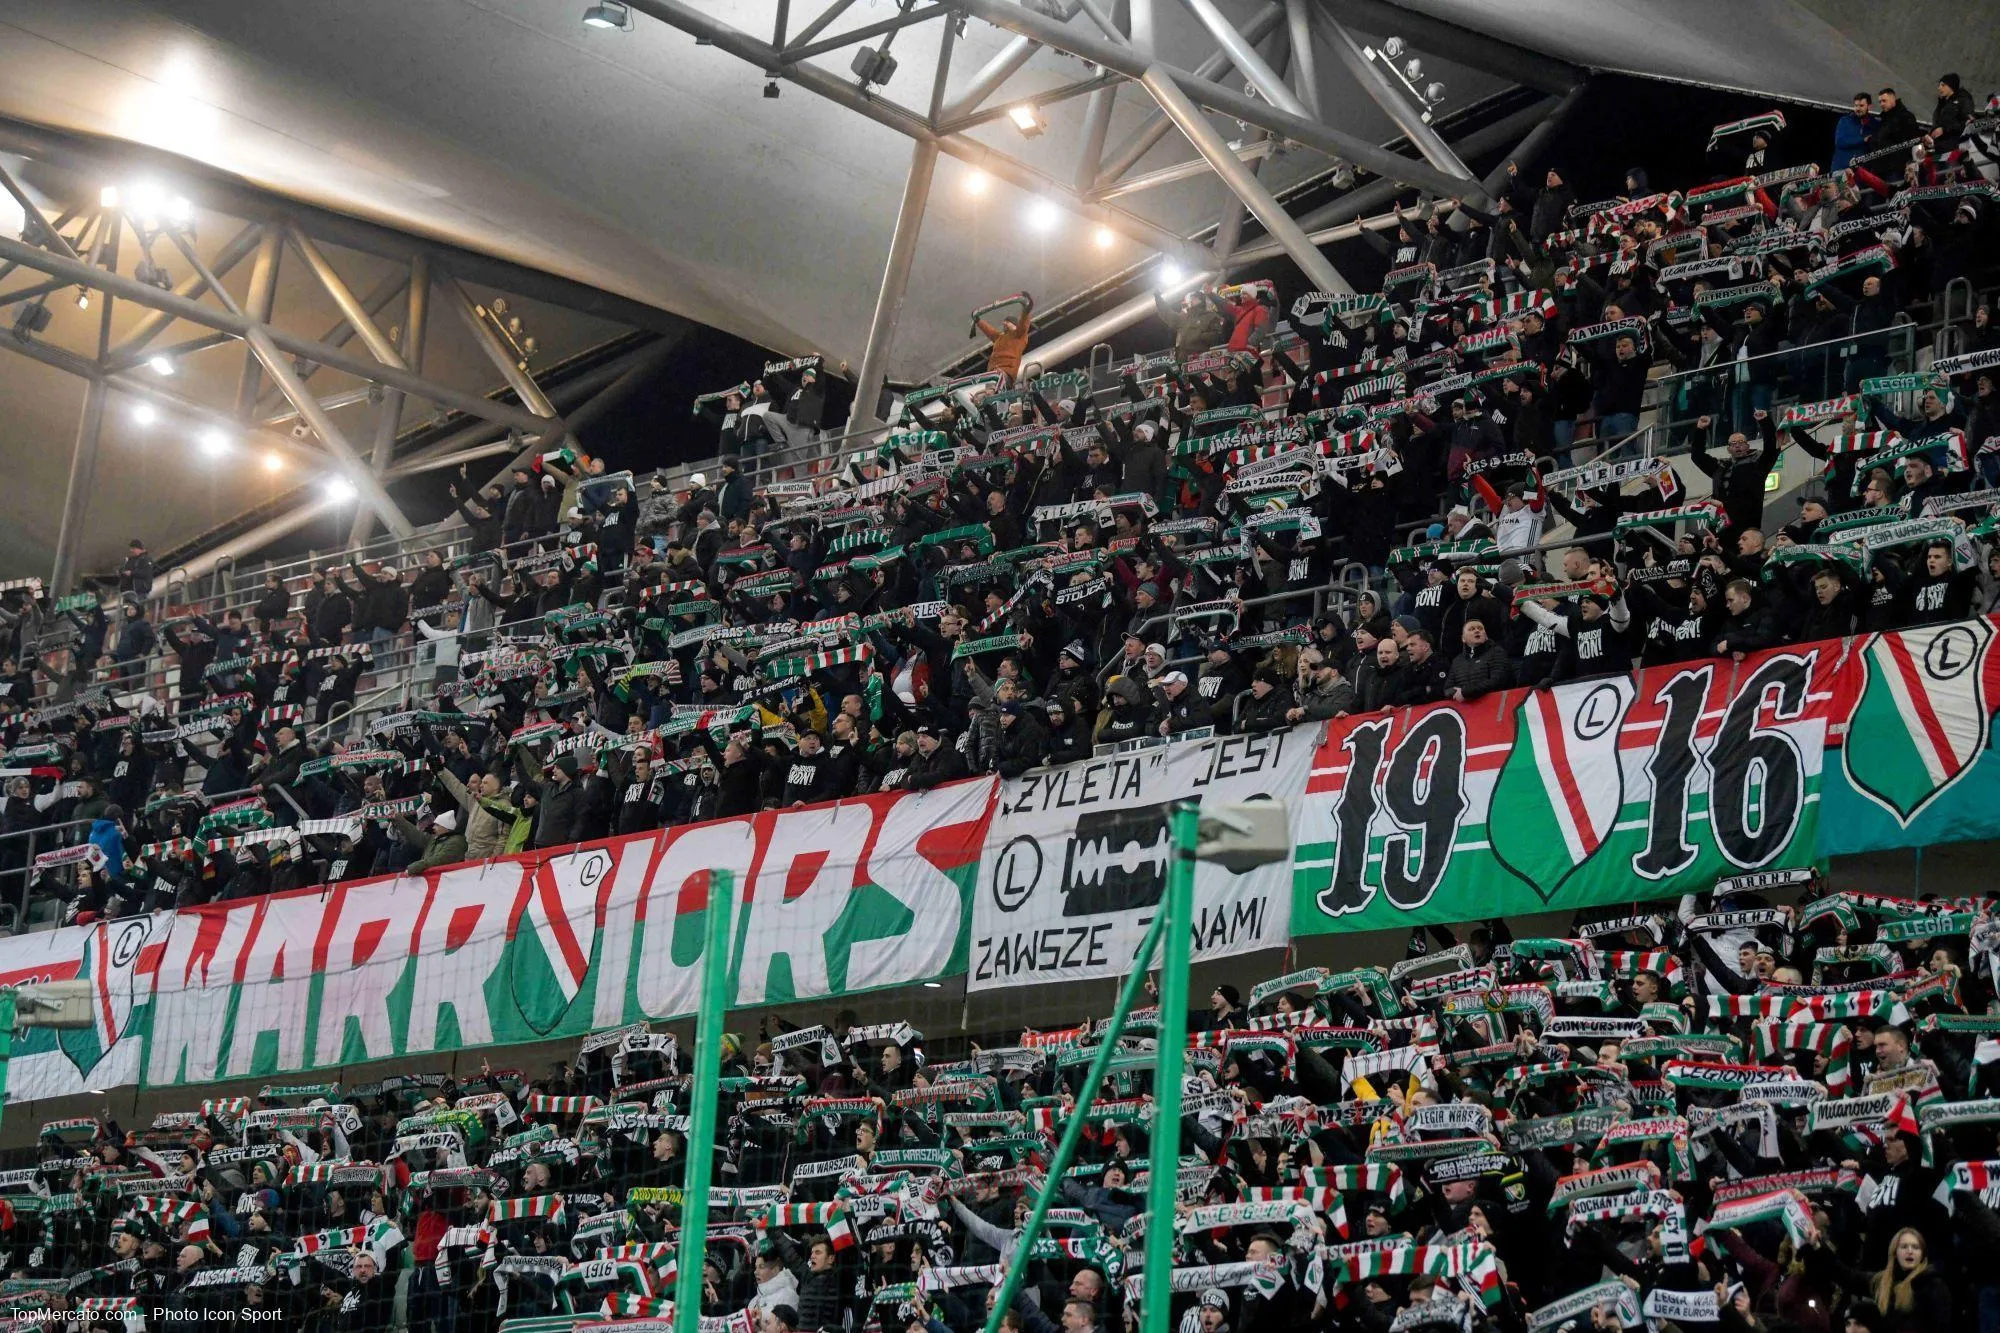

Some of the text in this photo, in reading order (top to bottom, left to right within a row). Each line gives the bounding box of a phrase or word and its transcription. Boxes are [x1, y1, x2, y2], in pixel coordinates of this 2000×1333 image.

[1467, 327, 1508, 351] LEGIA
[1871, 376, 1917, 392] LEGIA
[1790, 396, 1853, 421] LEGIA
[889, 432, 938, 451] LEGIA
[1579, 458, 1660, 485] LEGIA
[751, 585, 769, 595] 1916
[1577, 637, 1602, 659] WON!
[1192, 725, 1293, 788] JEST
[147, 779, 996, 1087] WARRIORS
[1903, 917, 1954, 936] LEGIA
[975, 922, 1112, 981] ZAWSZE
[1190, 897, 1267, 950] NAMI
[1423, 971, 1482, 997] LEGIA
[1026, 1030, 1074, 1053] LEGIA
[896, 1088, 919, 1101] LEGIA
[829, 1100, 878, 1113] WARSZAWA
[1101, 1103, 1137, 1117] DEYNA
[1419, 1109, 1445, 1124] LEGIA
[1576, 1116, 1611, 1133] LEGIA
[876, 1148, 951, 1165] LEGIA WARSZAWA
[1430, 1154, 1509, 1174] LEGIA WARSZAWA
[794, 1161, 815, 1176] LEGIA
[1457, 1165, 1476, 1177] DEN
[1713, 1173, 1833, 1203] LEGIA WARSZAWA
[855, 1197, 880, 1212] 1916
[1573, 1195, 1620, 1216] KOCHANY
[1622, 1192, 1649, 1207] KLUB
[1194, 1204, 1296, 1228] LEGIA
[513, 1257, 564, 1273] WARSZAWA
[585, 1262, 613, 1278] 1916
[1177, 1271, 1211, 1289] 100%
[1653, 1290, 1687, 1306] LEGIA
[1654, 1303, 1716, 1318] UEFA EUROPA
